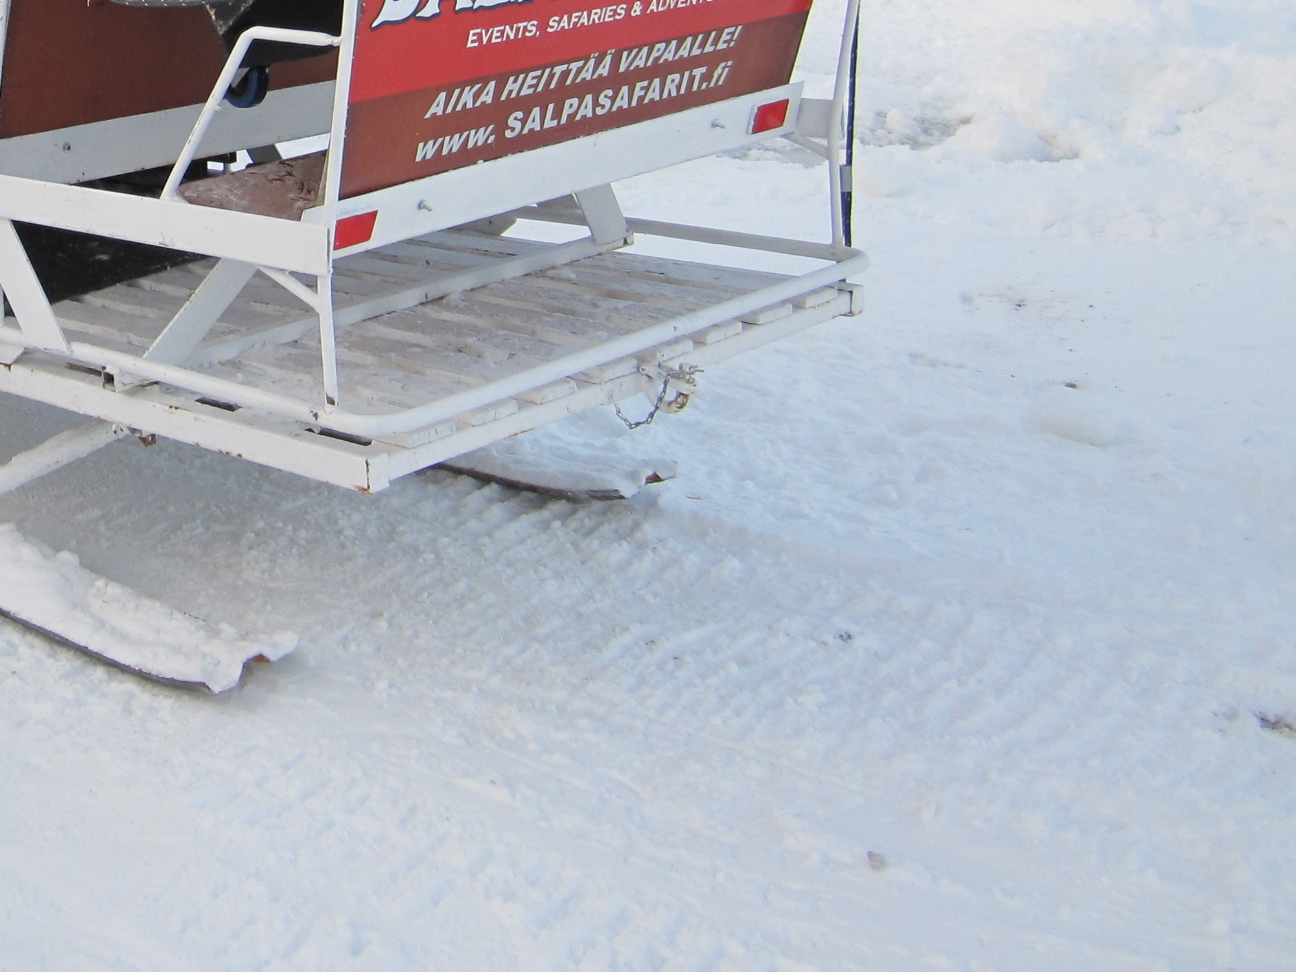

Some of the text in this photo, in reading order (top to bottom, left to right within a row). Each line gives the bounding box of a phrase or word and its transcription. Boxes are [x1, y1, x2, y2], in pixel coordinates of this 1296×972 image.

[466, 20, 540, 48] EVENTS,
[546, 4, 627, 33] SAFARIES
[630, 1, 643, 17] &
[424, 25, 743, 119] AIKA HEITTÄÄ VAPAALLE!
